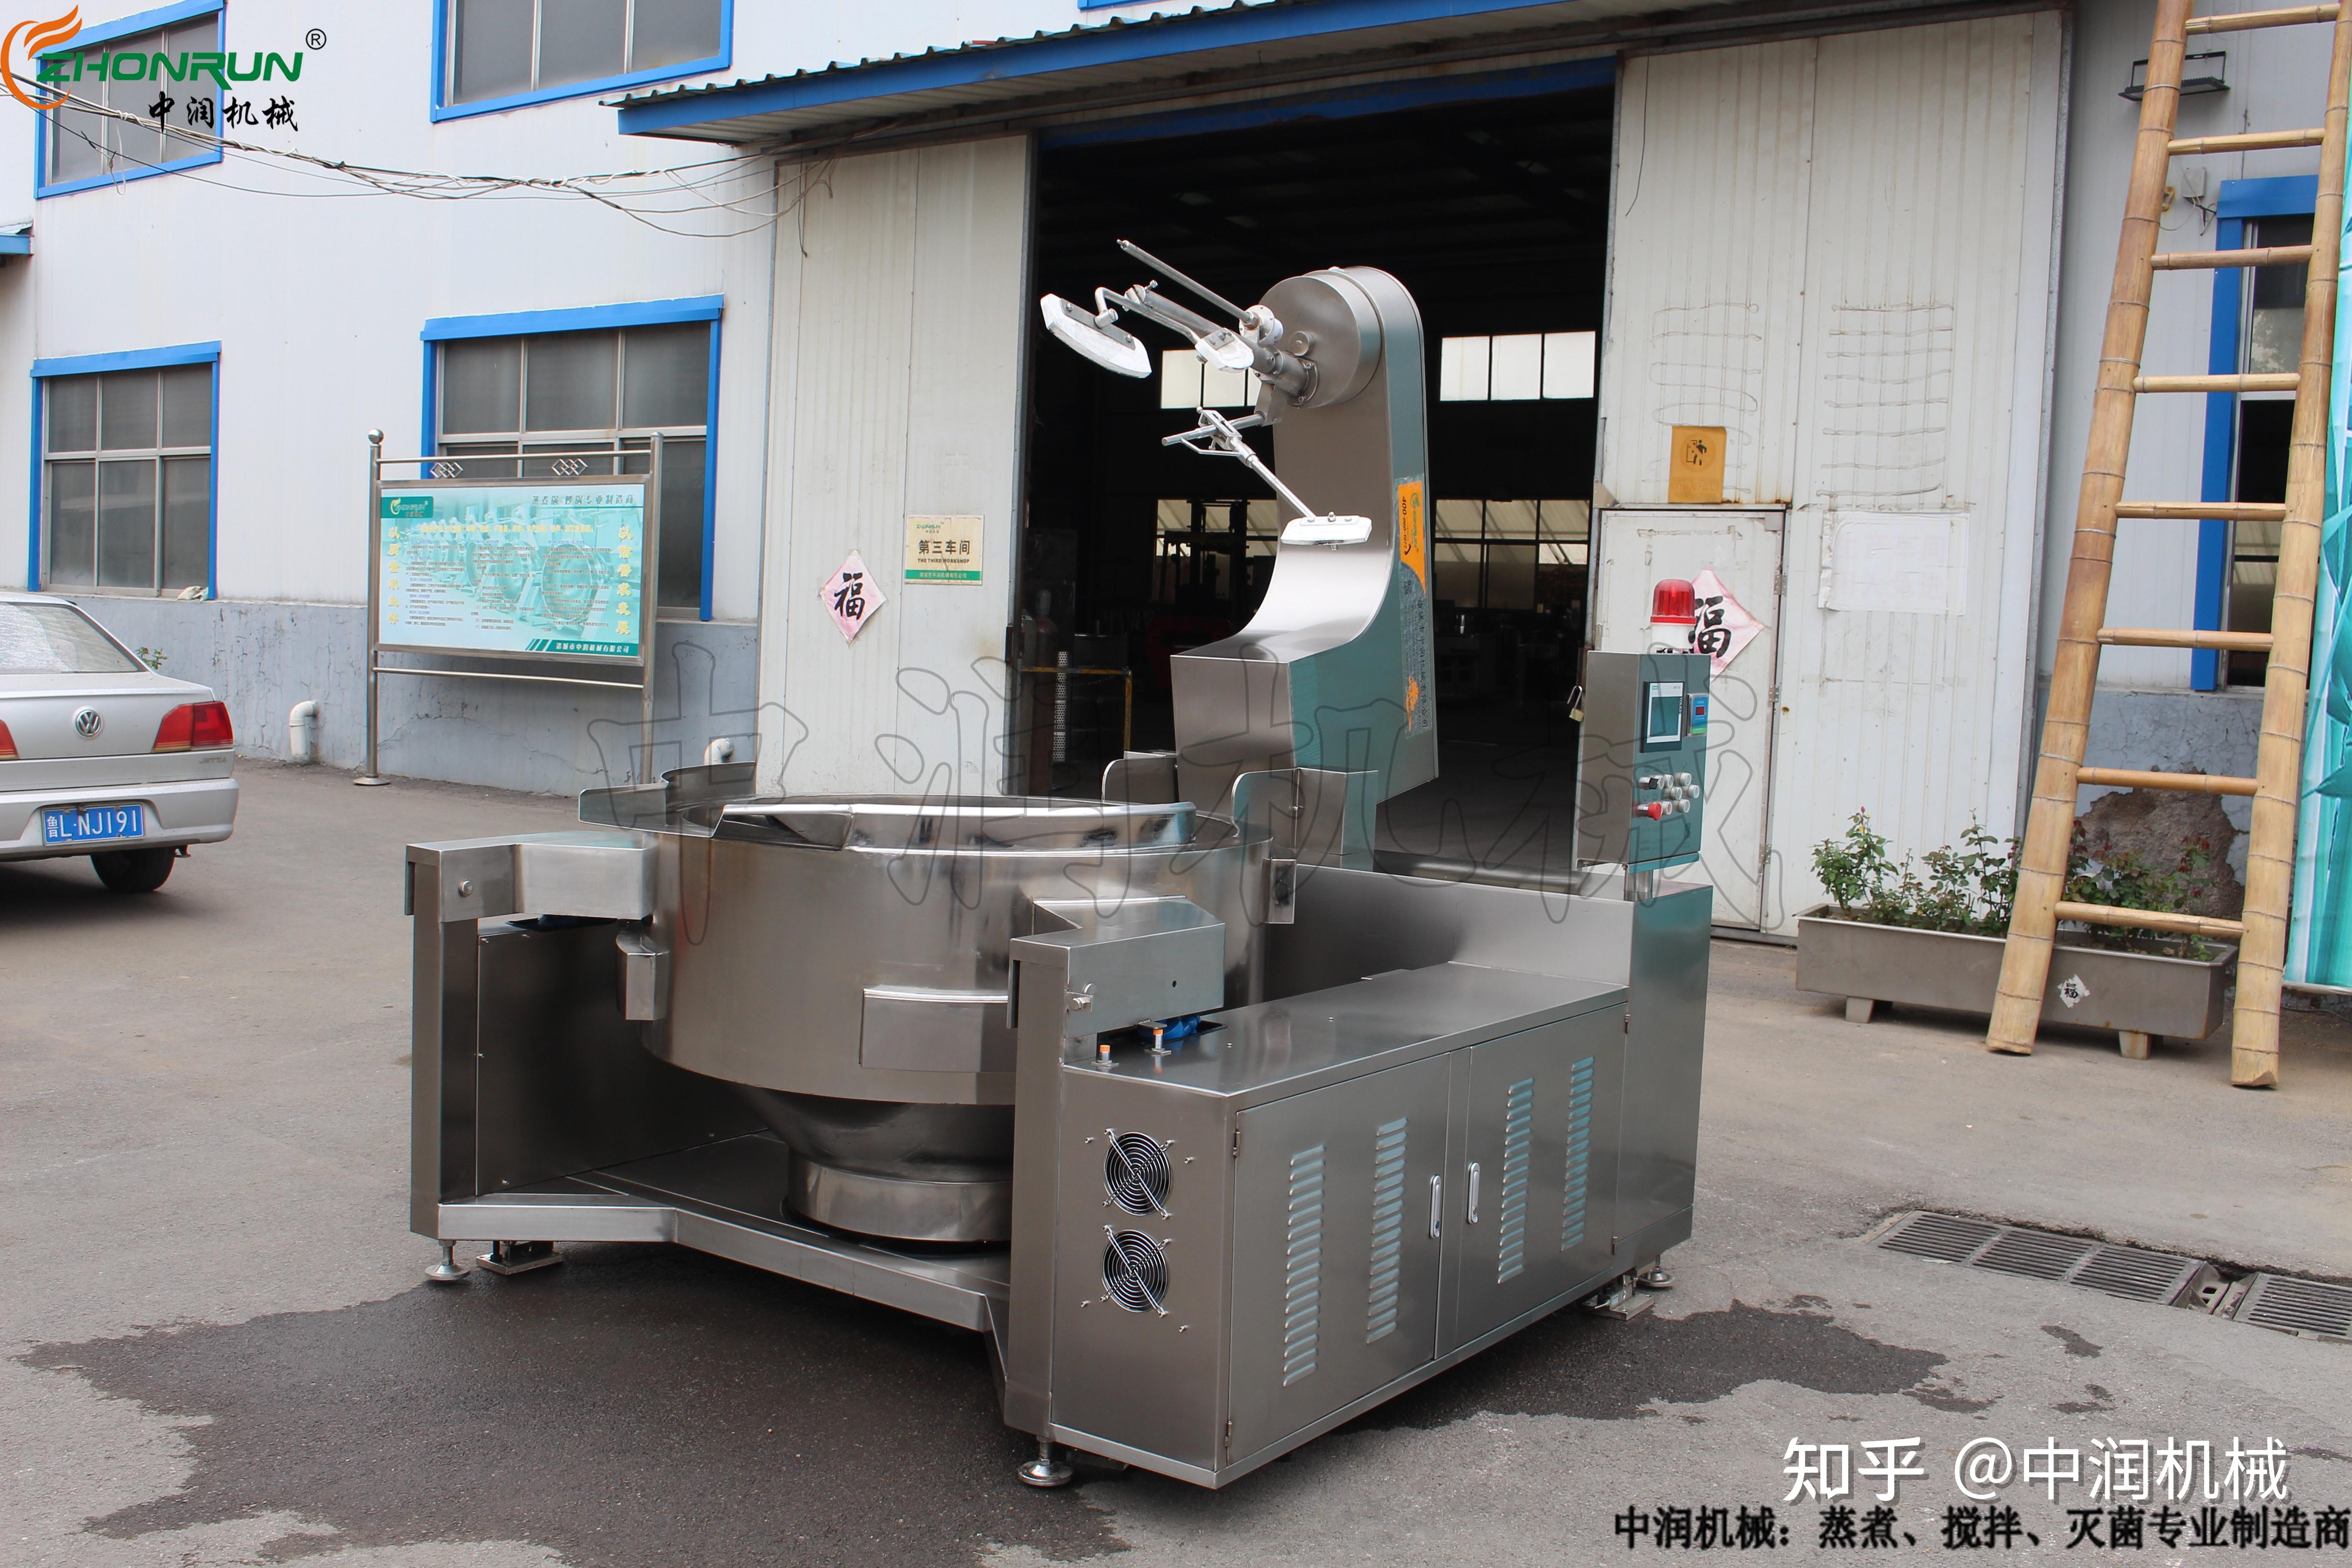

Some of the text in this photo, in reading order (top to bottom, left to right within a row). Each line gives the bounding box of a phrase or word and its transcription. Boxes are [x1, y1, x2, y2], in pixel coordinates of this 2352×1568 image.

[918, 539, 970, 555] 第三车间
[834, 572, 865, 620] 福
